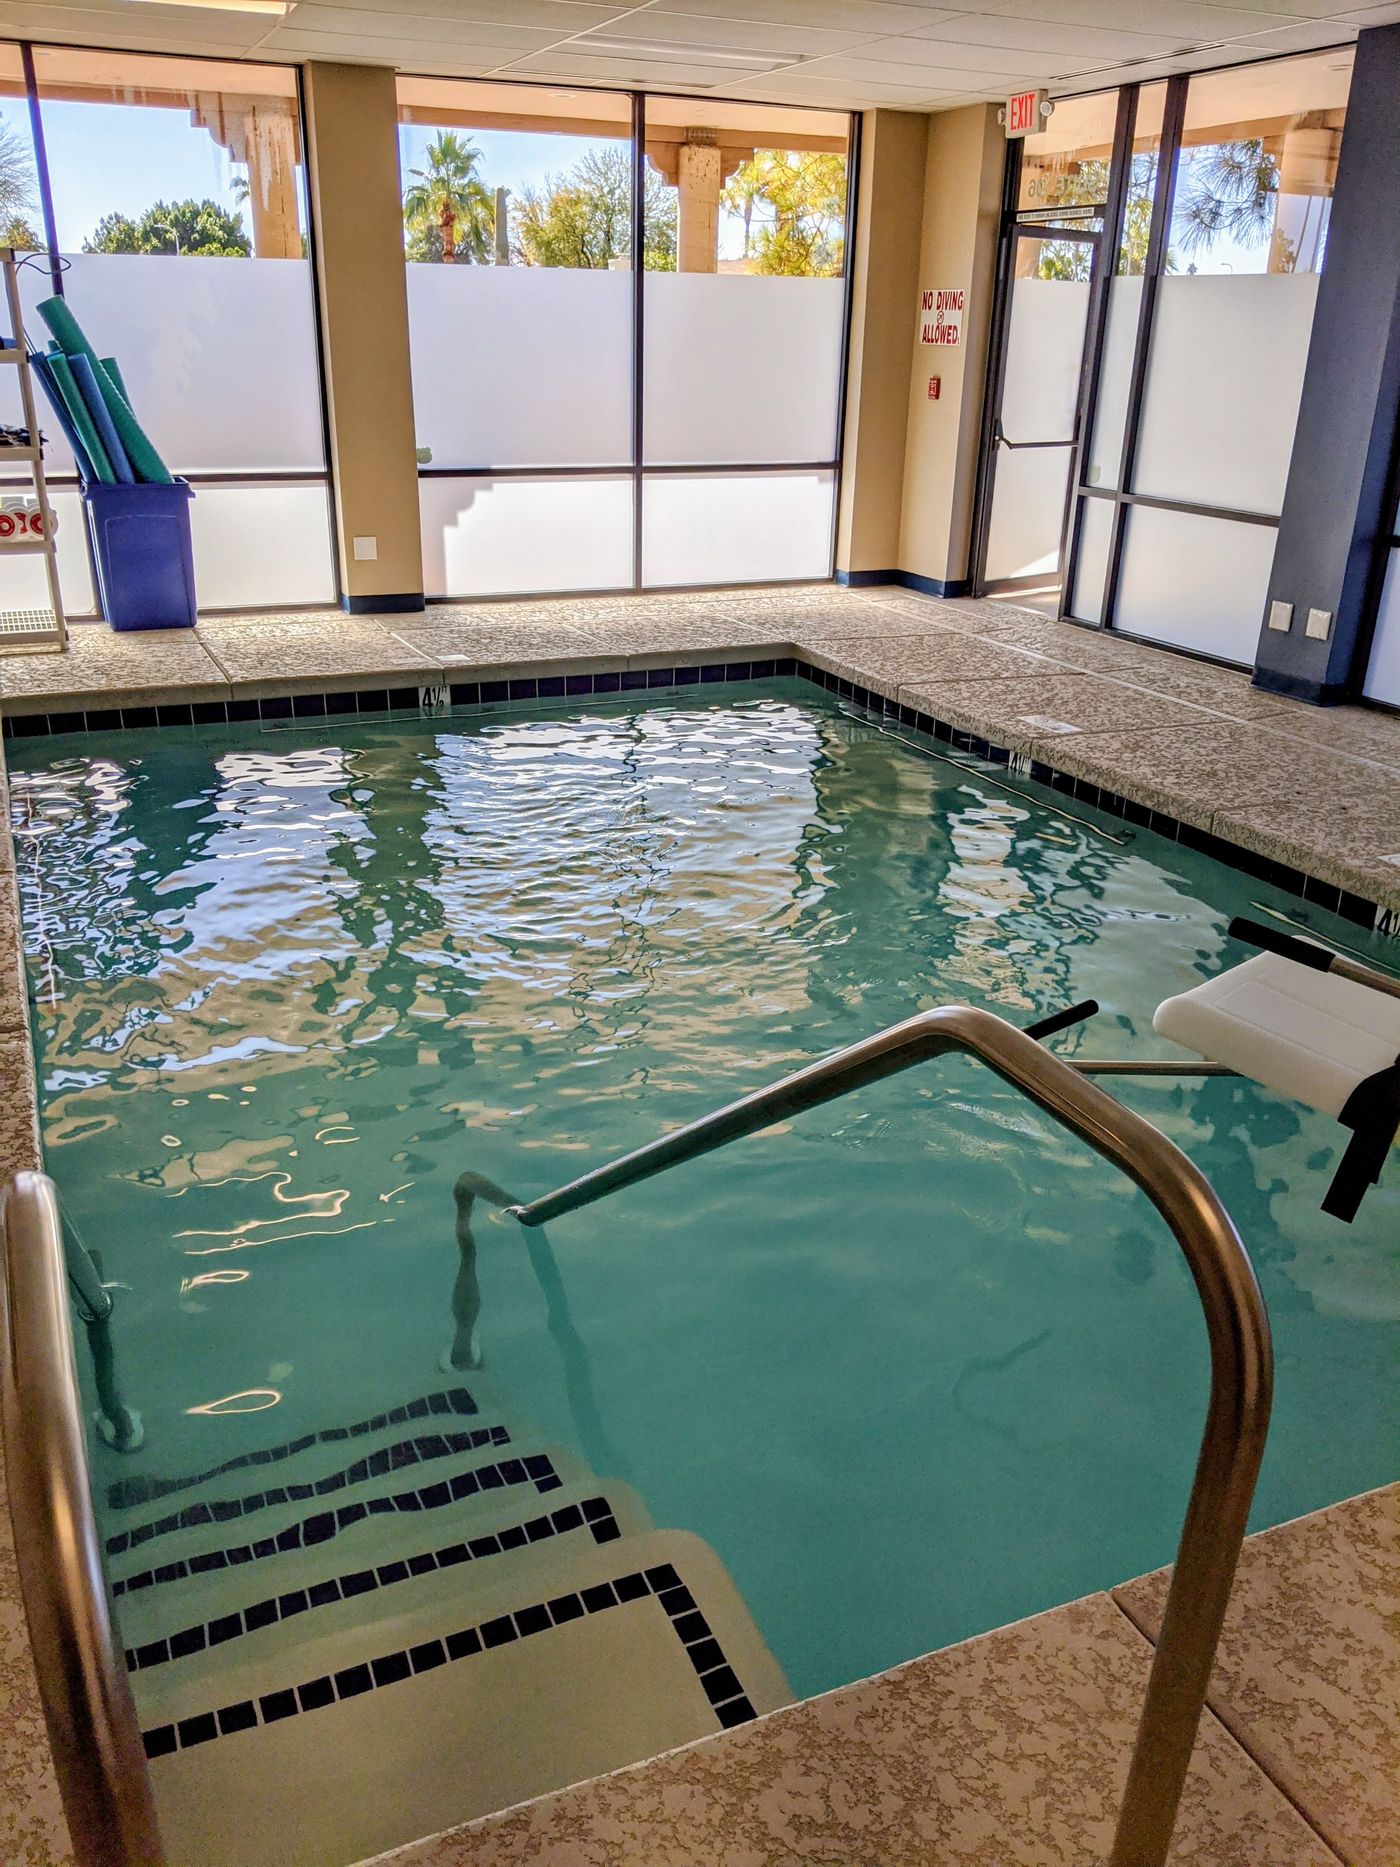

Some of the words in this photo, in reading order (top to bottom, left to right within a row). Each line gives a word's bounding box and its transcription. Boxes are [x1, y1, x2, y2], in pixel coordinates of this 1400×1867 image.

[1010, 93, 1035, 131] EXIT
[922, 291, 933, 310] NO
[936, 290, 964, 311] DIVING
